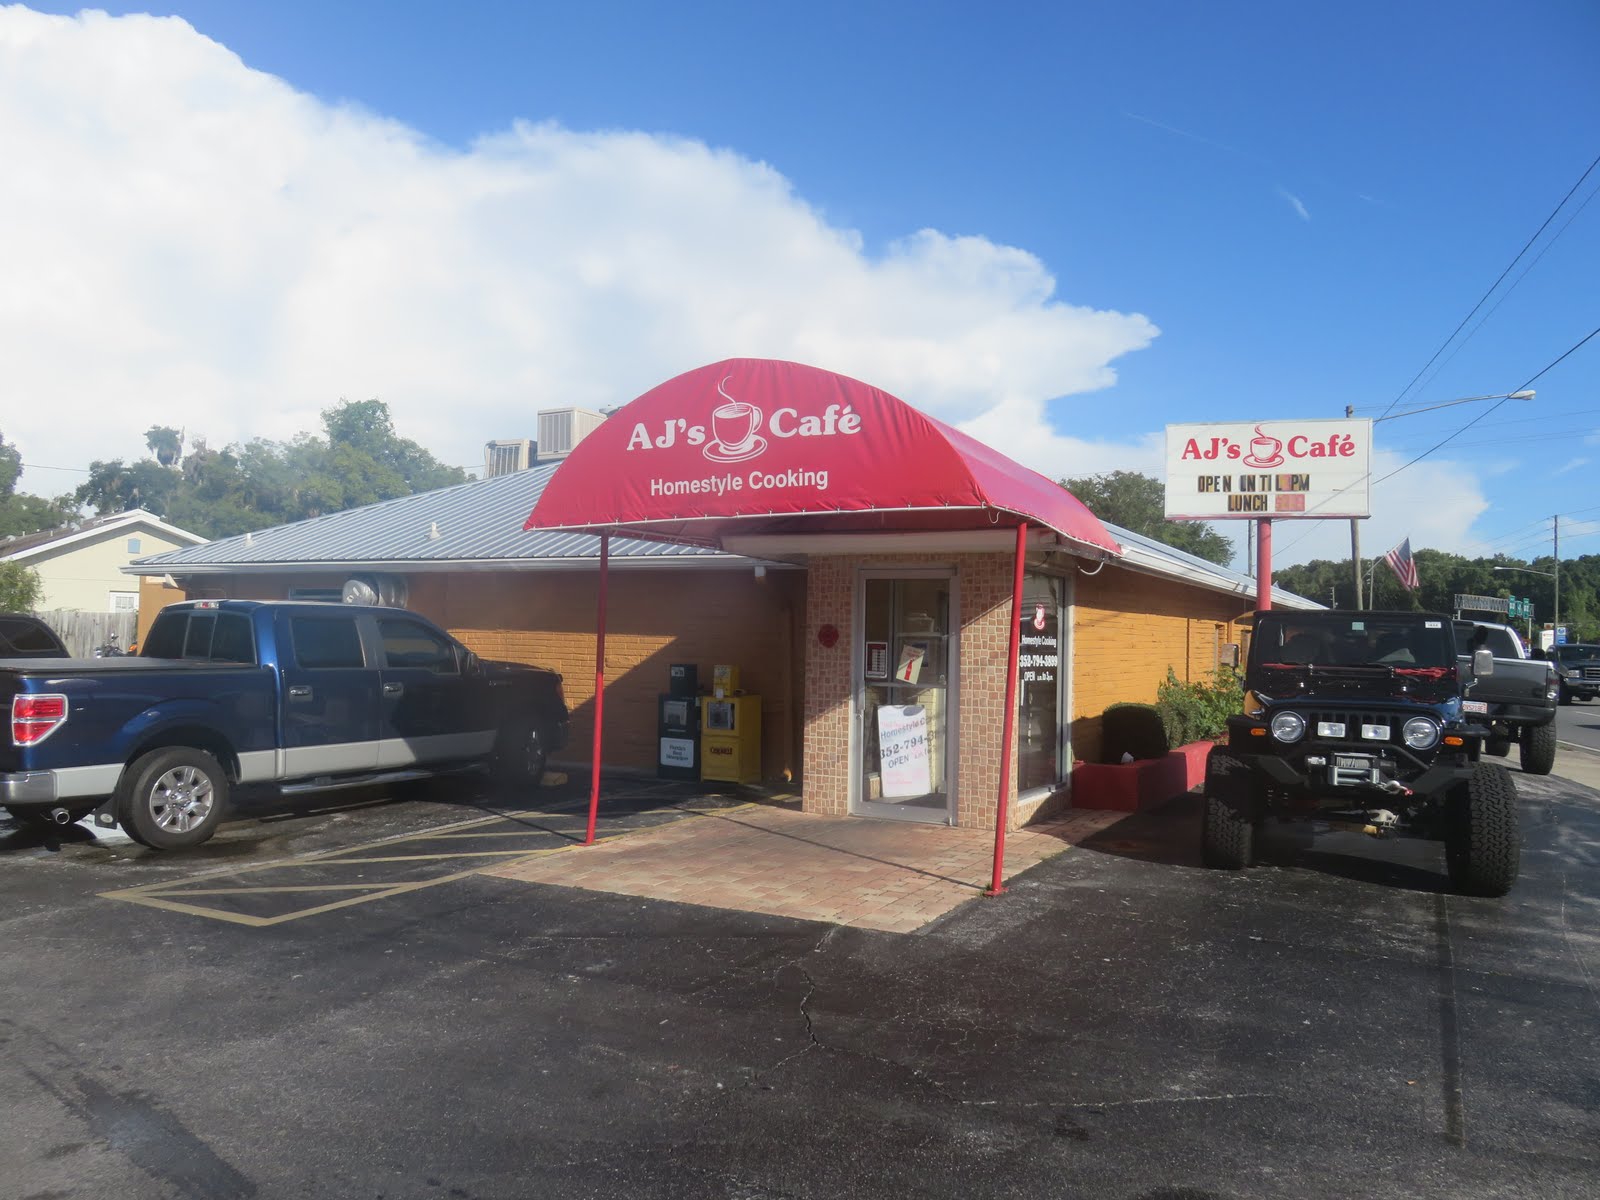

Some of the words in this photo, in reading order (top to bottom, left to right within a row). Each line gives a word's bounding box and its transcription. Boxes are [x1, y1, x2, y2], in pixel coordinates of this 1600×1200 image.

[626, 418, 706, 451] AJ's
[768, 404, 862, 438] Café
[1181, 437, 1241, 460] AJ's
[1287, 434, 1355, 459] Café
[650, 473, 743, 497] Homestyle
[748, 468, 829, 491] Cooking
[1198, 474, 1232, 493] OPEN
[1227, 494, 1268, 512] LUNCH
[888, 754, 910, 769] OPEN
